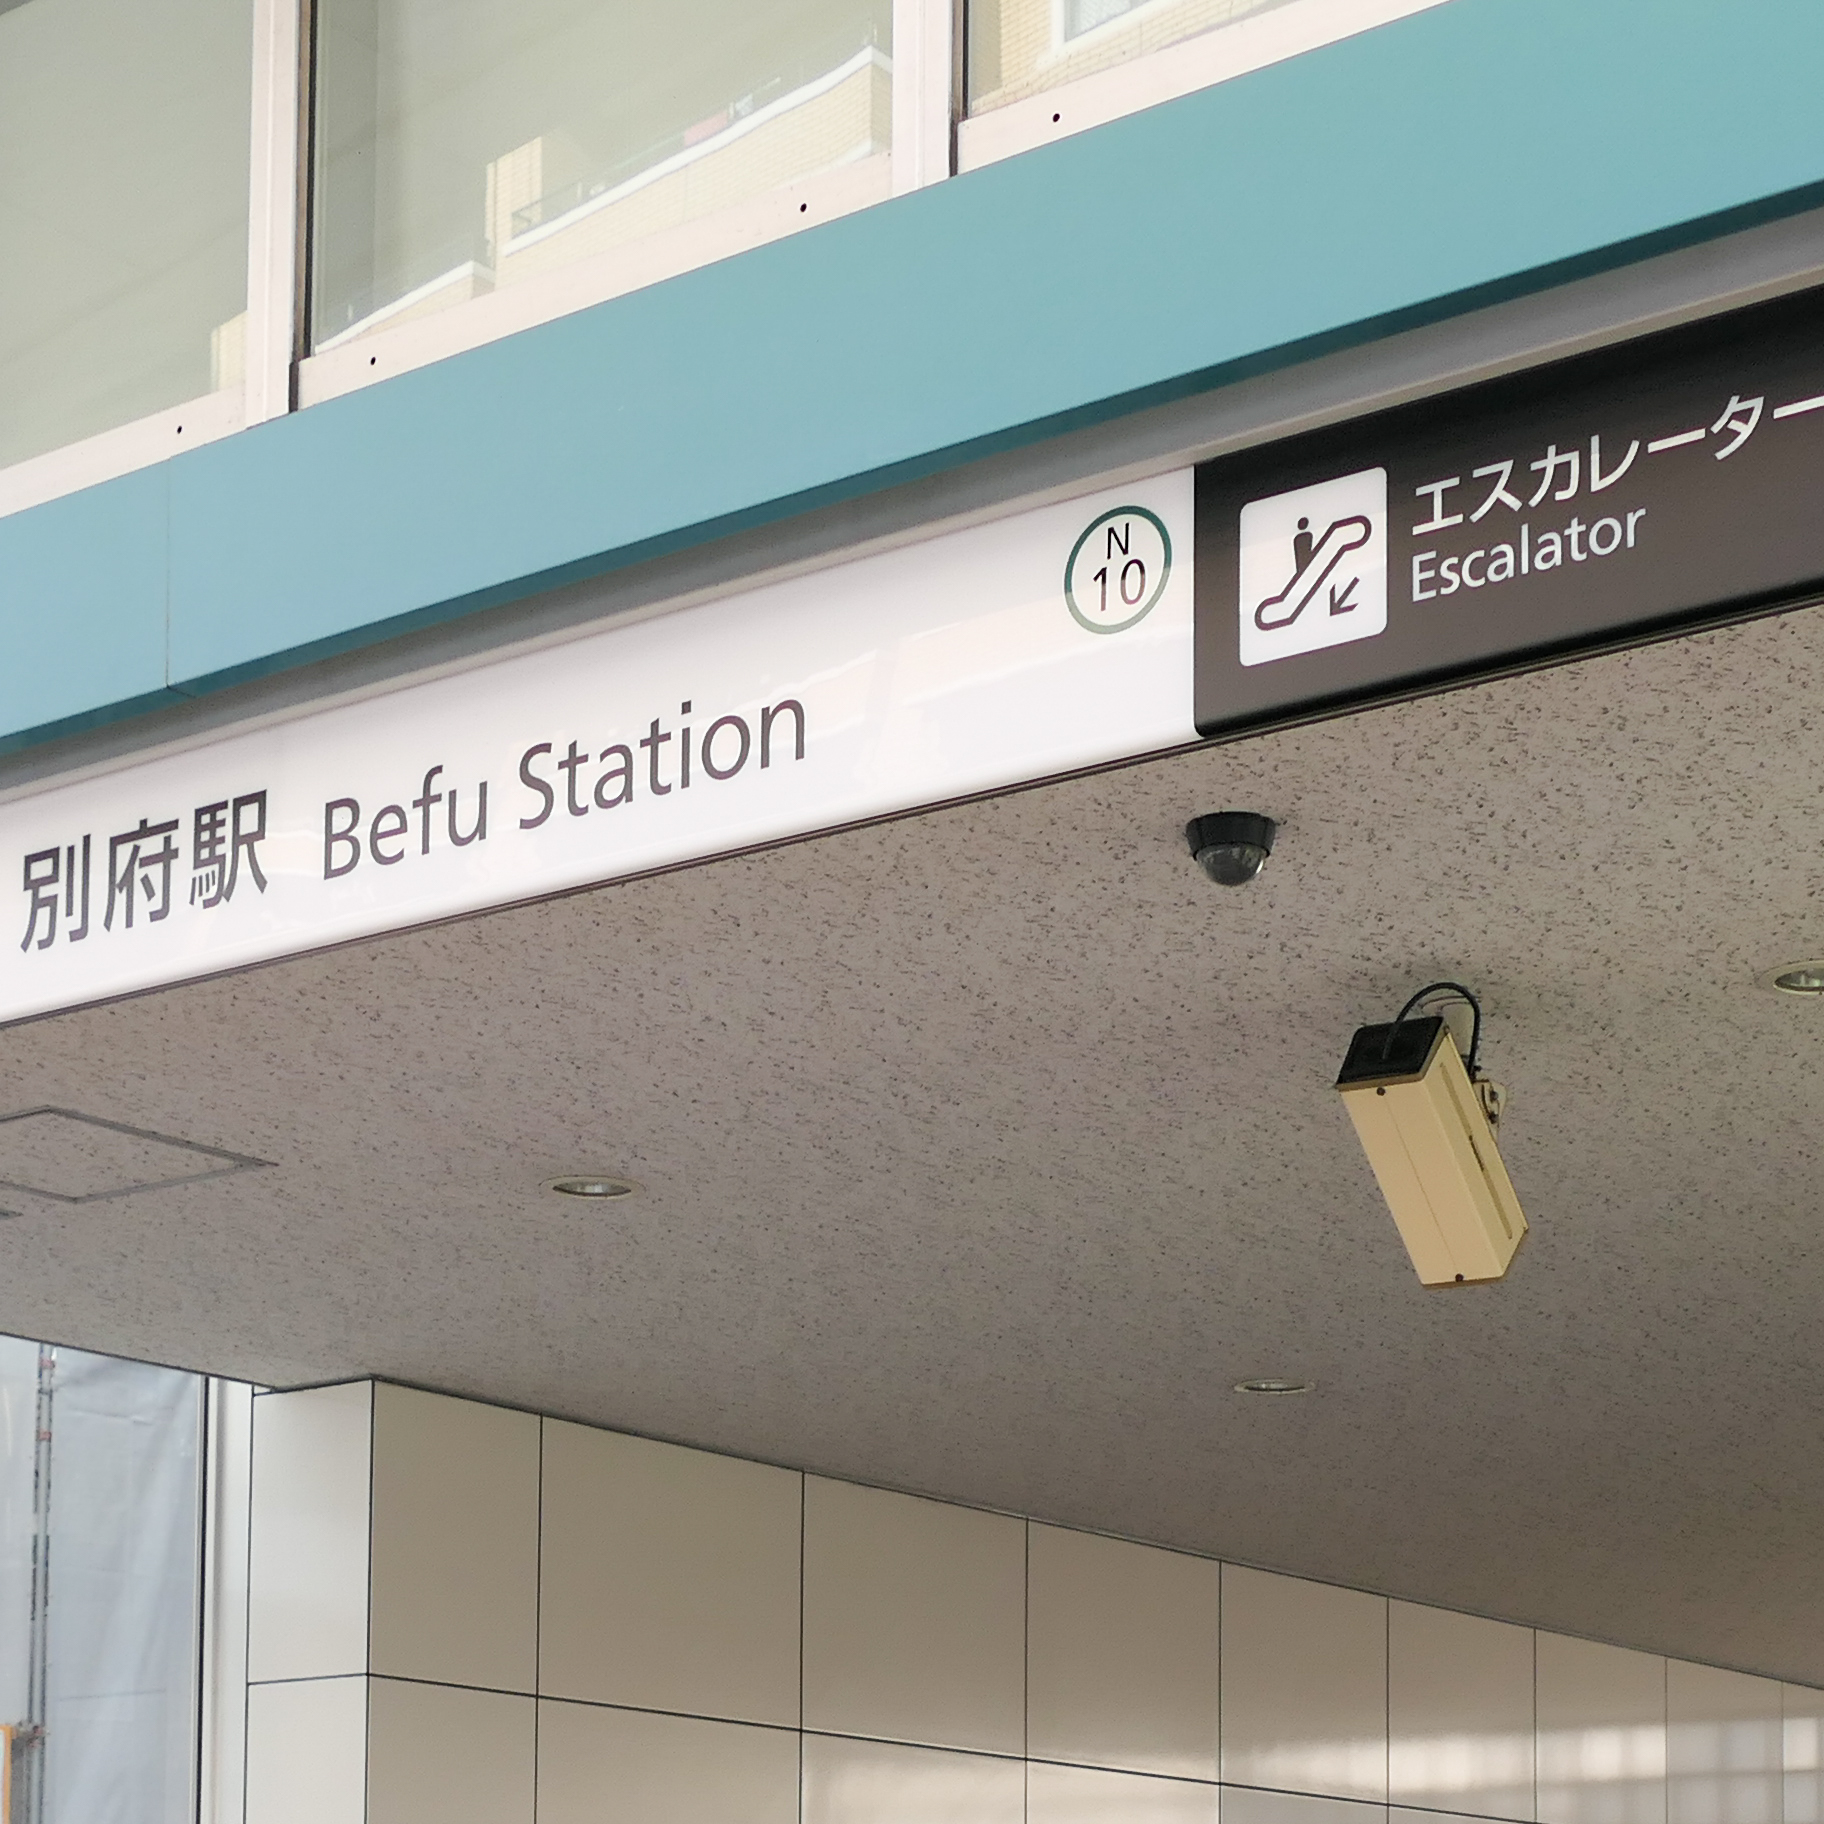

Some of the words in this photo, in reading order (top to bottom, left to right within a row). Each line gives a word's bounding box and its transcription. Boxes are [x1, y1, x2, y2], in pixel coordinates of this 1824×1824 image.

[1105, 521, 1131, 558] N
[1412, 502, 1648, 602] Escalator
[1090, 557, 1147, 615] 10
[20, 787, 270, 954] 別府駅
[323, 763, 489, 881] Befu
[518, 697, 806, 831] Station
